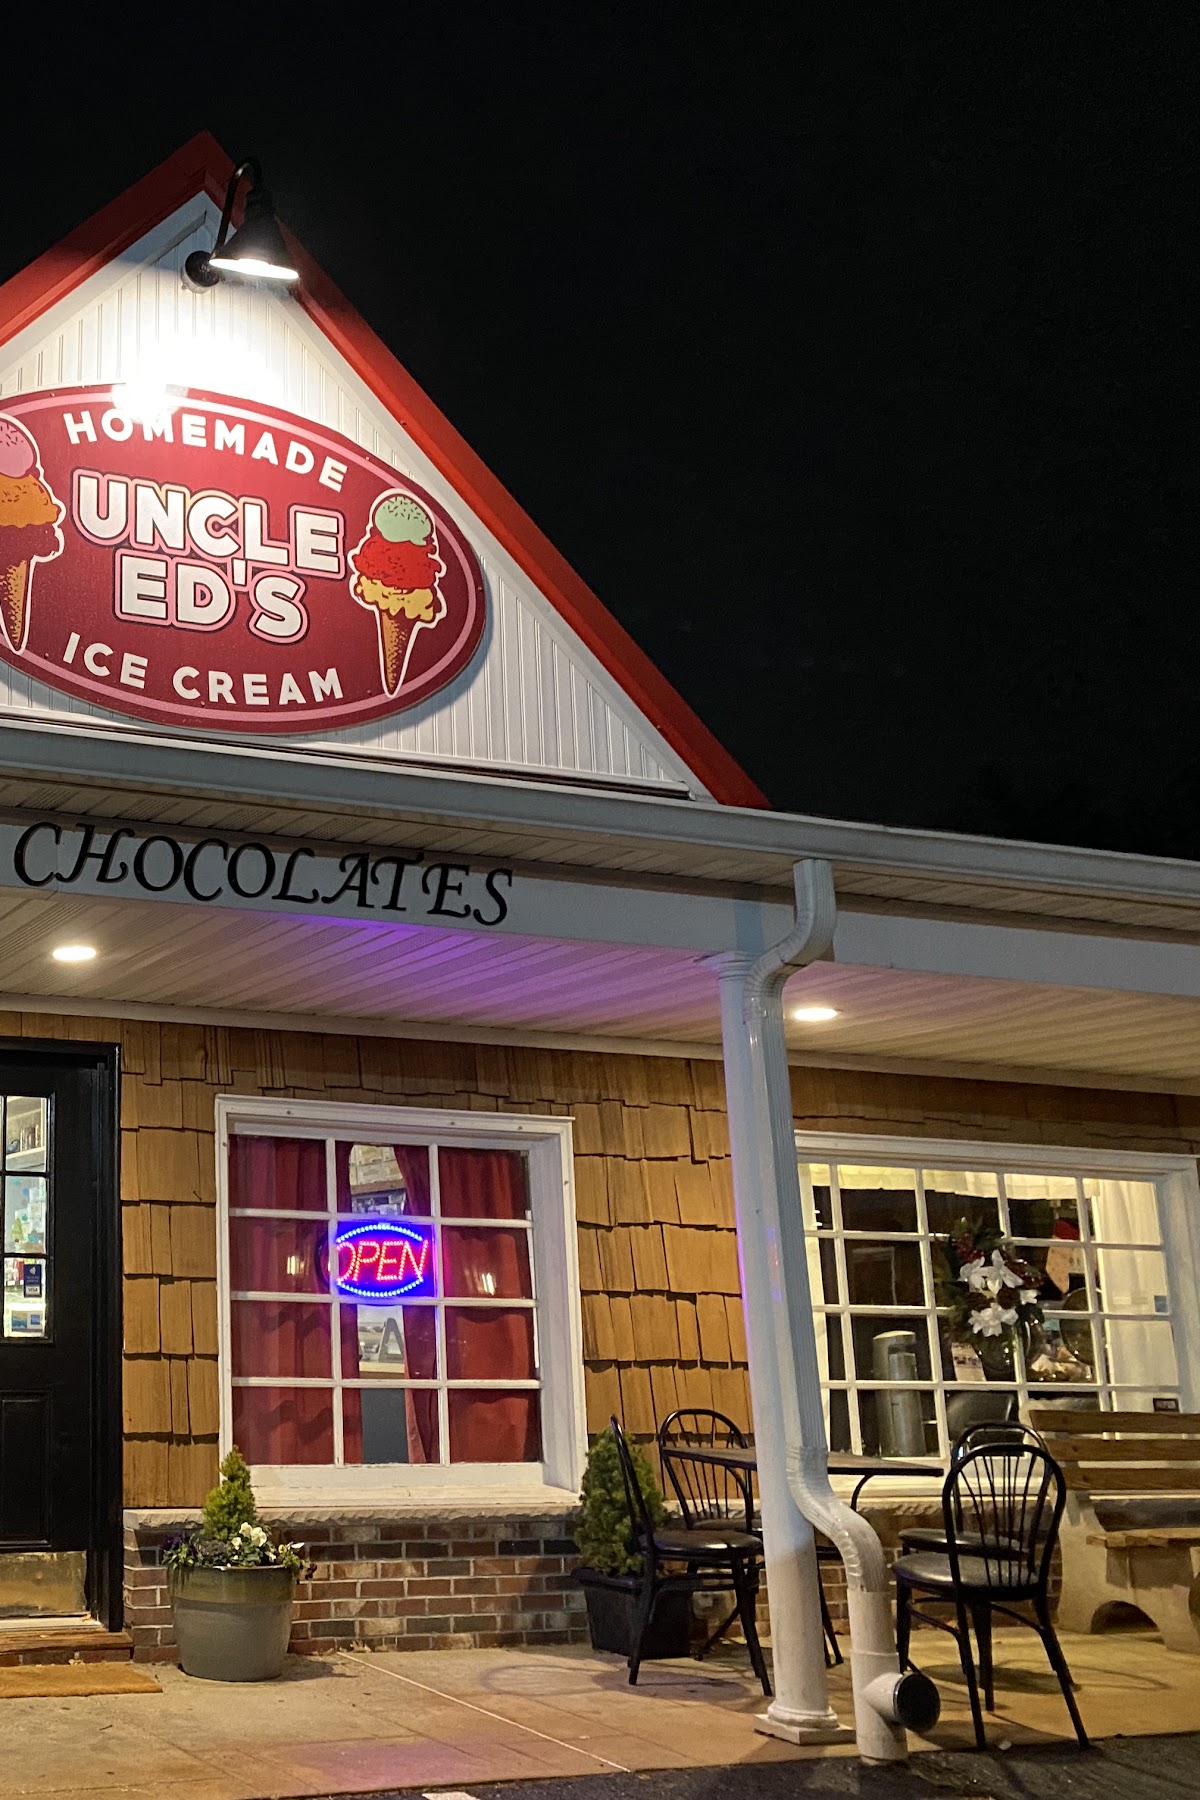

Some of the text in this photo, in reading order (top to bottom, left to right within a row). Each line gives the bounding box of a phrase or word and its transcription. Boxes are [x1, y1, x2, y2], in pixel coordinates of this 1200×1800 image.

[63, 409, 349, 493] HOMEMADE
[74, 472, 343, 577] UNCLE
[119, 555, 303, 639] ED'S
[63, 632, 344, 705] ICE CREAM
[13, 821, 513, 926] CHOCOLATES
[336, 1239, 429, 1282] OPEN
